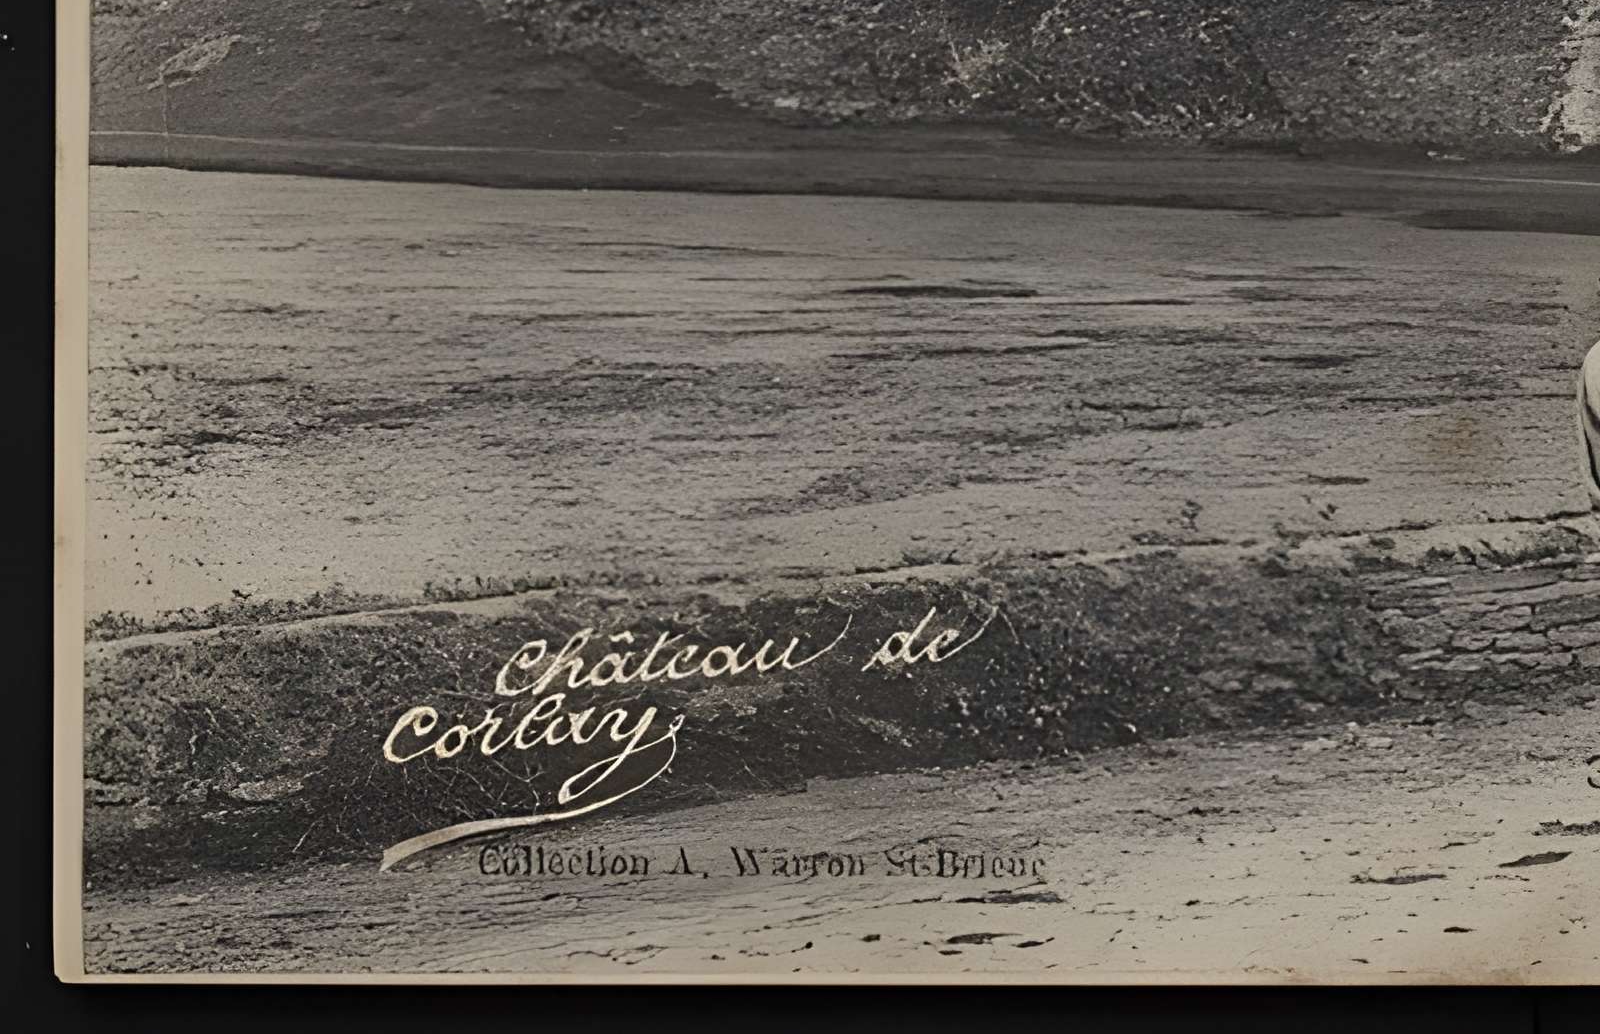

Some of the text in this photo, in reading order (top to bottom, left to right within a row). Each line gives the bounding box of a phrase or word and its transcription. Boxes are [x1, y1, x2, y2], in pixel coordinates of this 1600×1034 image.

[496, 606, 999, 697] Château de
[381, 691, 686, 804] Corlay
